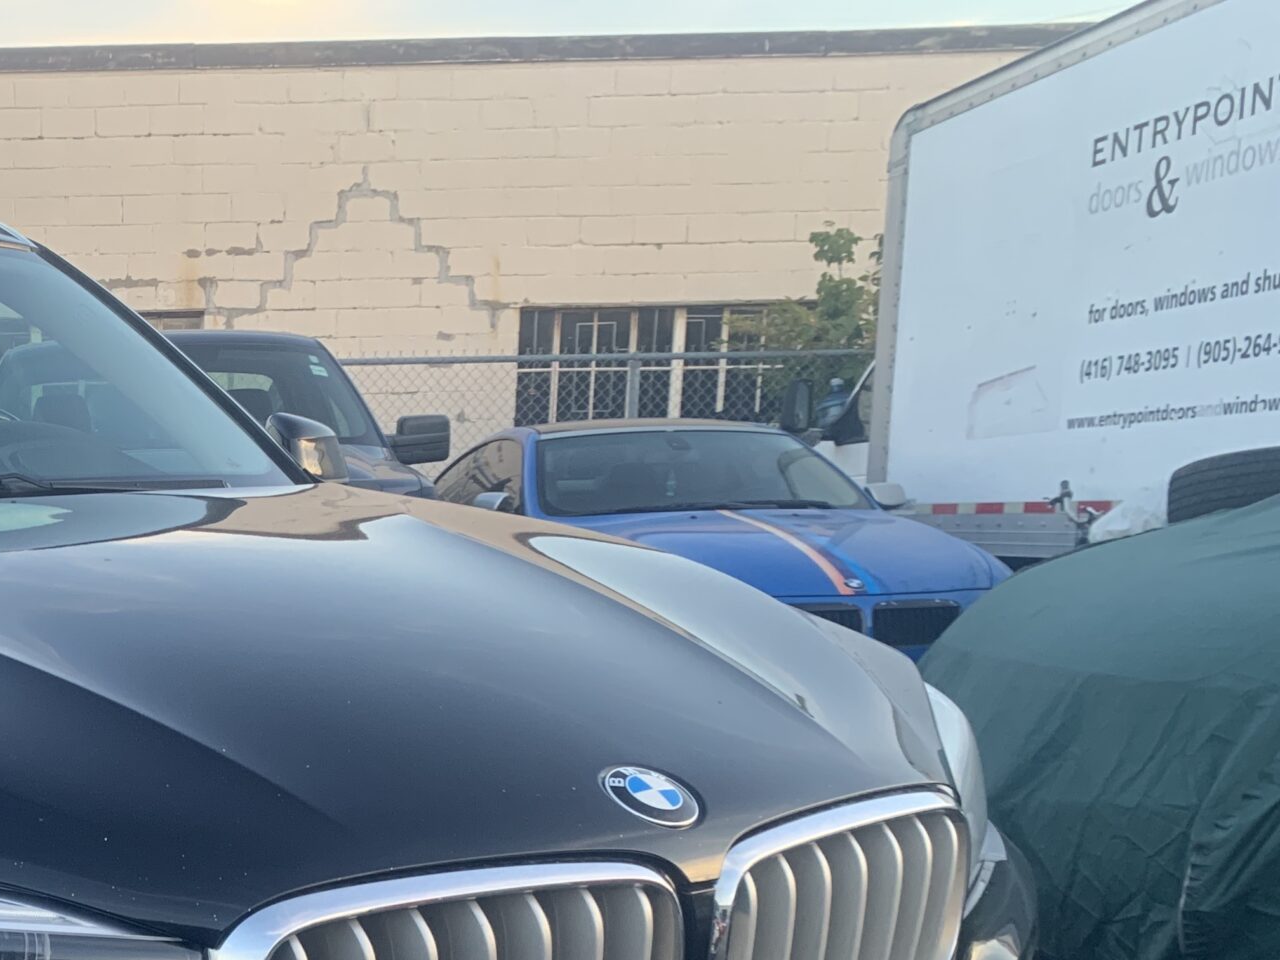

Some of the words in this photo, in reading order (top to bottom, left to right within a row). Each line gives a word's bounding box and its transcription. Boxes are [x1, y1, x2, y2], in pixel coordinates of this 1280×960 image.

[1091, 73, 1280, 168] ENTRYPOIN
[1088, 180, 1144, 215] doors
[1146, 155, 1180, 219] &
[1185, 137, 1280, 188] window
[1087, 303, 1107, 325] for
[1109, 299, 1149, 317] doors,
[1153, 284, 1217, 312] windows
[1220, 271, 1251, 300] and
[1079, 356, 1113, 384] (416)
[1116, 347, 1179, 376] 748-3095
[1197, 333, 1280, 369] (905)-264-
